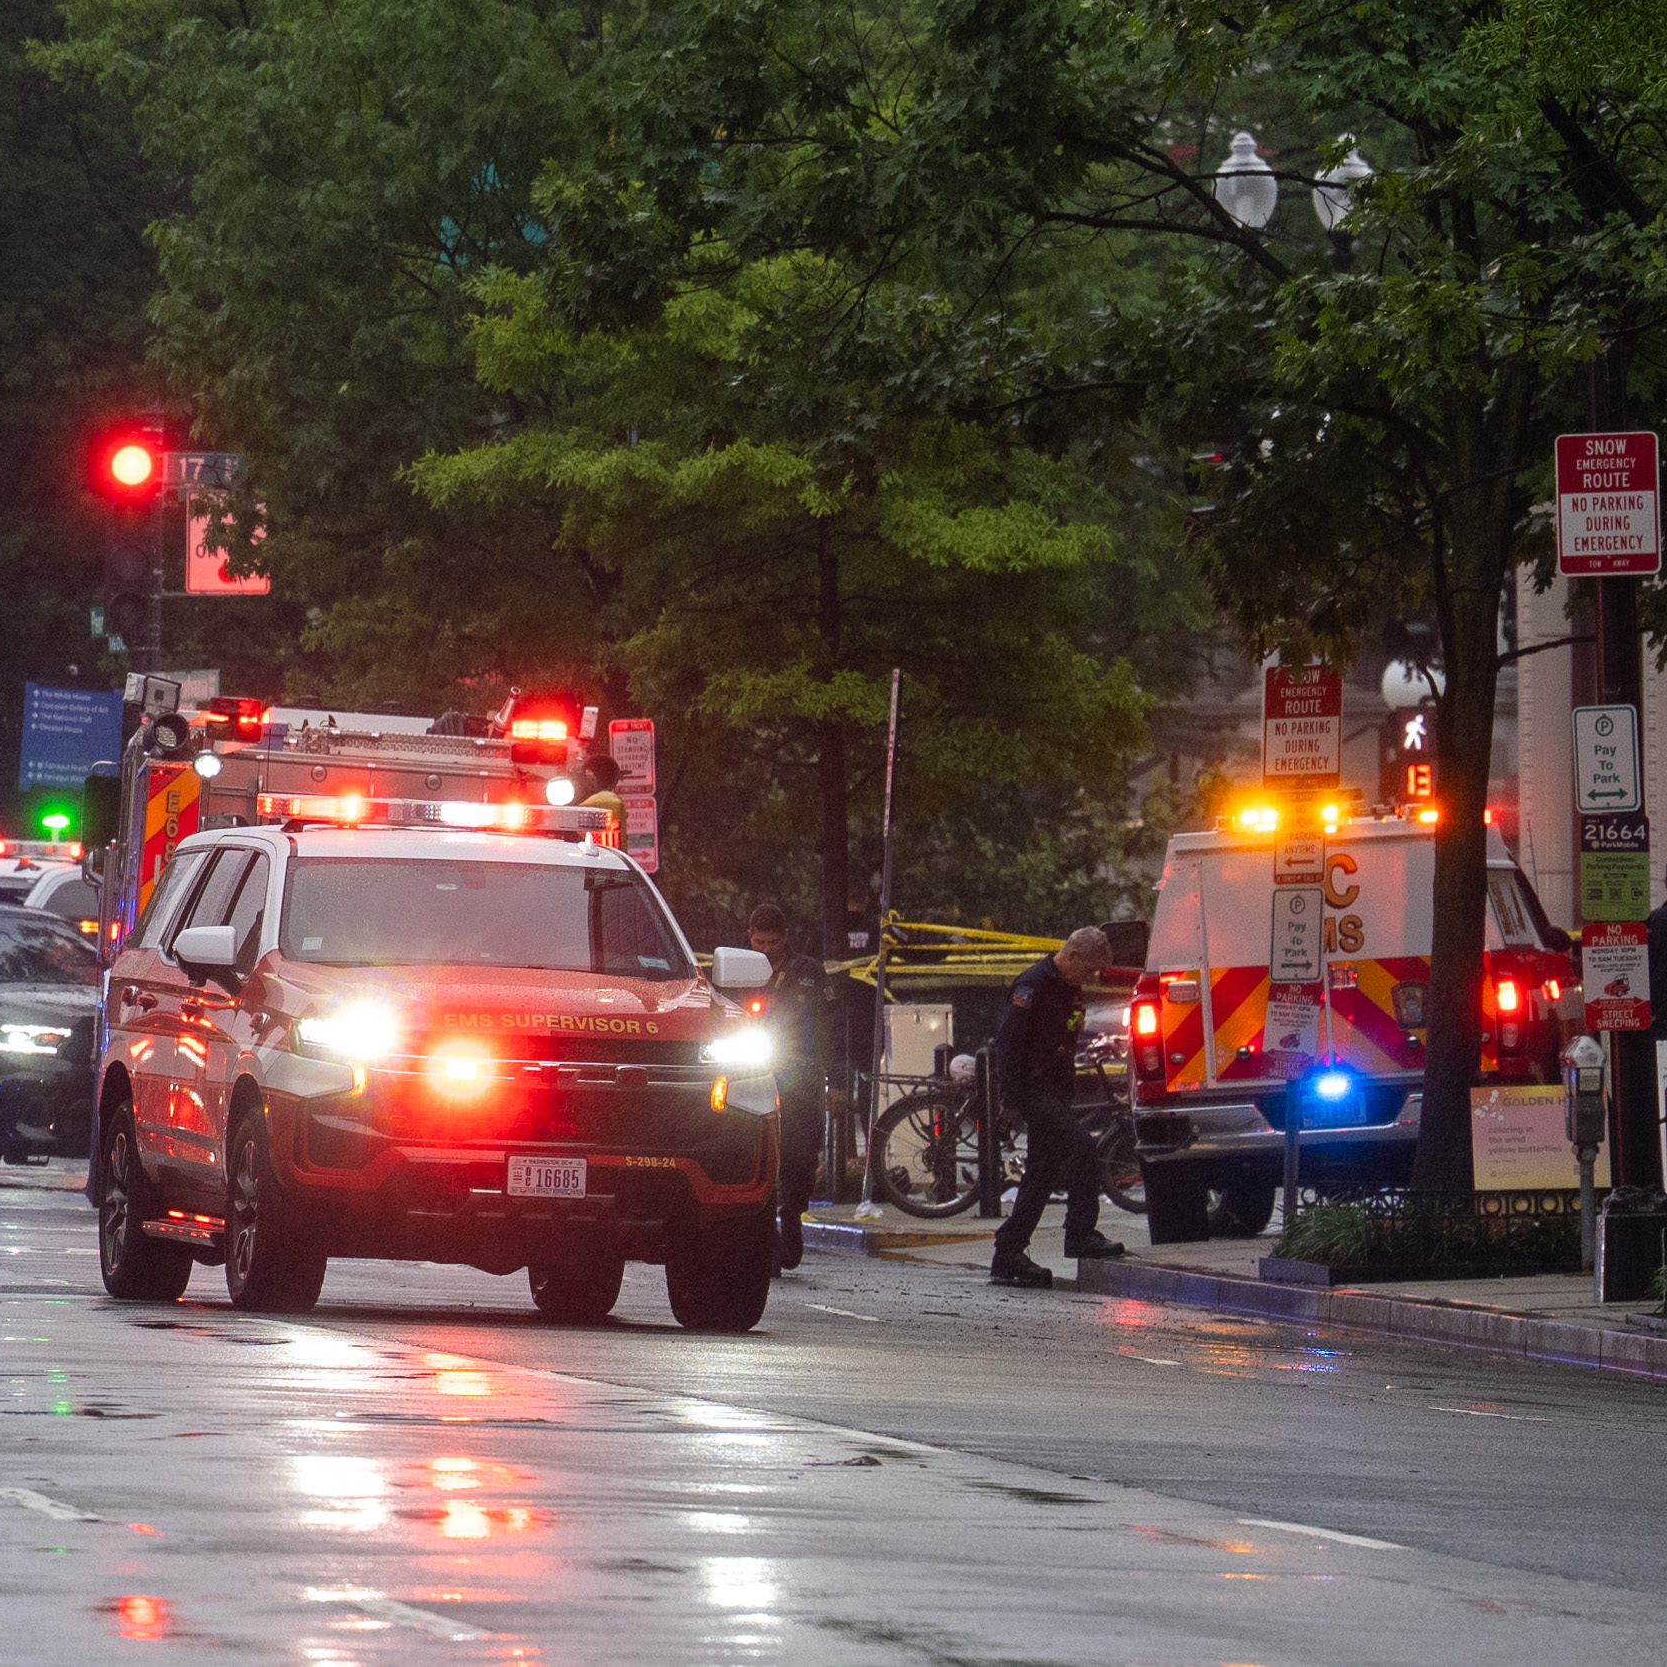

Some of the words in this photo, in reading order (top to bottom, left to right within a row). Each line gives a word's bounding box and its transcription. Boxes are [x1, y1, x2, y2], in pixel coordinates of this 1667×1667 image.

[1585, 439, 1627, 455] SNOW
[1576, 457, 1636, 470] EMERGENCY
[1583, 472, 1630, 488] ROUTE
[1572, 497, 1587, 512] NO
[1592, 495, 1643, 511] PARKING
[1586, 516, 1630, 531] DURING
[1574, 535, 1643, 552] EMERGENCY
[1589, 560, 1602, 568] TOW
[1280, 686, 1327, 698] EMERGENCY
[1285, 700, 1322, 714] ROUTE
[1275, 723, 1287, 736] NO
[1291, 721, 1331, 736] PARKING
[1285, 739, 1320, 754] DURING
[1594, 745, 1617, 757] Pay
[1275, 756, 1329, 772] EMERGENCY
[1598, 760, 1614, 770] To
[1408, 764, 1432, 796] 13
[1593, 772, 1620, 784] Park
[1585, 824, 1646, 840] 21664
[1284, 844, 1316, 854] ANYTIME
[1324, 853, 1360, 909] C
[1287, 921, 1307, 933] Pay
[1607, 925, 1622, 935] NO
[1592, 935, 1638, 946] PARKING
[1284, 947, 1308, 957] Park
[1289, 985, 1302, 994] NO
[1276, 993, 1314, 1005] PARKING
[1602, 1010, 1633, 1019] STREET
[443, 1013, 493, 1028] EMS
[500, 1014, 641, 1034] SUPERVISOR
[646, 1021, 659, 1034] 6
[1597, 1018, 1641, 1029] SWEEPING
[1488, 1136, 1502, 1144] the
[1505, 1136, 1526, 1144] wind
[1488, 1146, 1517, 1155] yellow
[625, 1156, 676, 1169] S-298-24
[536, 1168, 580, 1189] 16685
